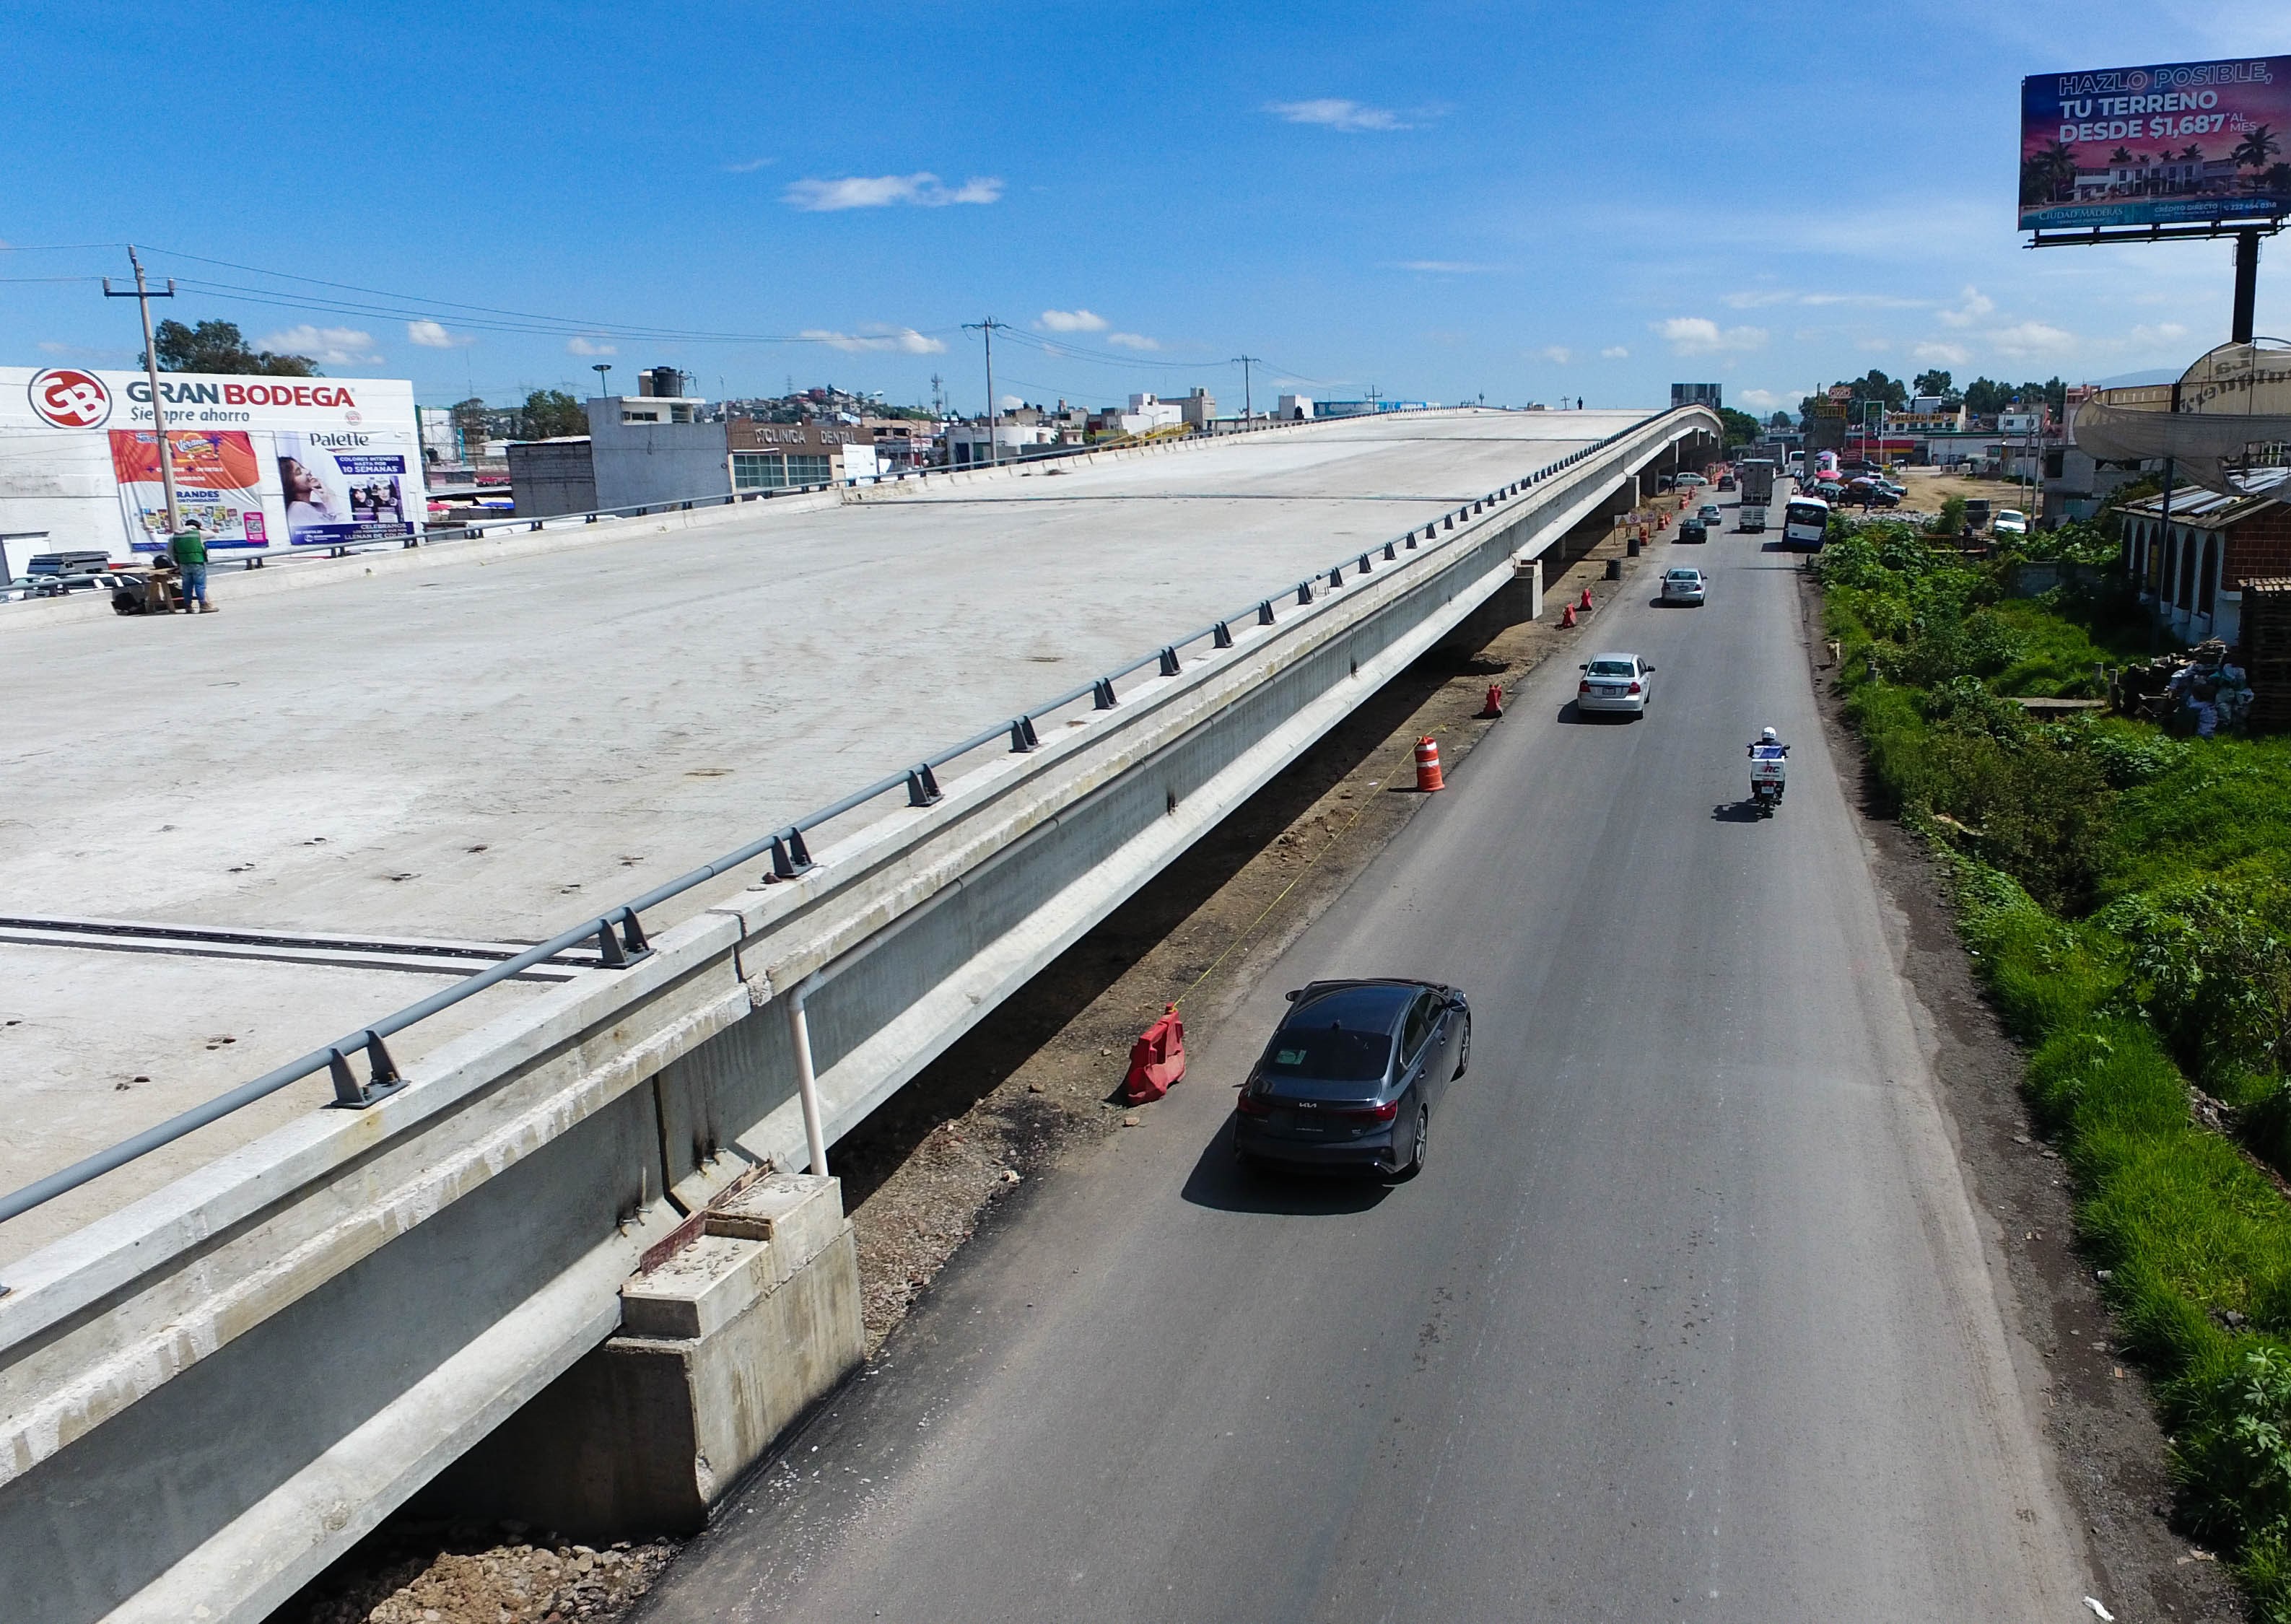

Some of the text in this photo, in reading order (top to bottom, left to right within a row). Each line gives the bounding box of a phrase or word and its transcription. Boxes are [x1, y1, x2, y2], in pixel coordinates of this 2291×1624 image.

[2059, 62, 2273, 96] HAZLO POSIBLE,
[2059, 90, 2218, 120] TU TERRENO
[2059, 120, 2143, 144] DESDE
[2230, 112, 2247, 123] AL
[2230, 121, 2257, 133] MES
[2039, 206, 2124, 220] CIUDAD MADERAS
[2186, 202, 2218, 211] DIRECTO
[38, 377, 105, 423] GB
[200, 408, 250, 422] ahorro
[310, 433, 370, 446] Palette
[821, 429, 857, 445] DENTAL
